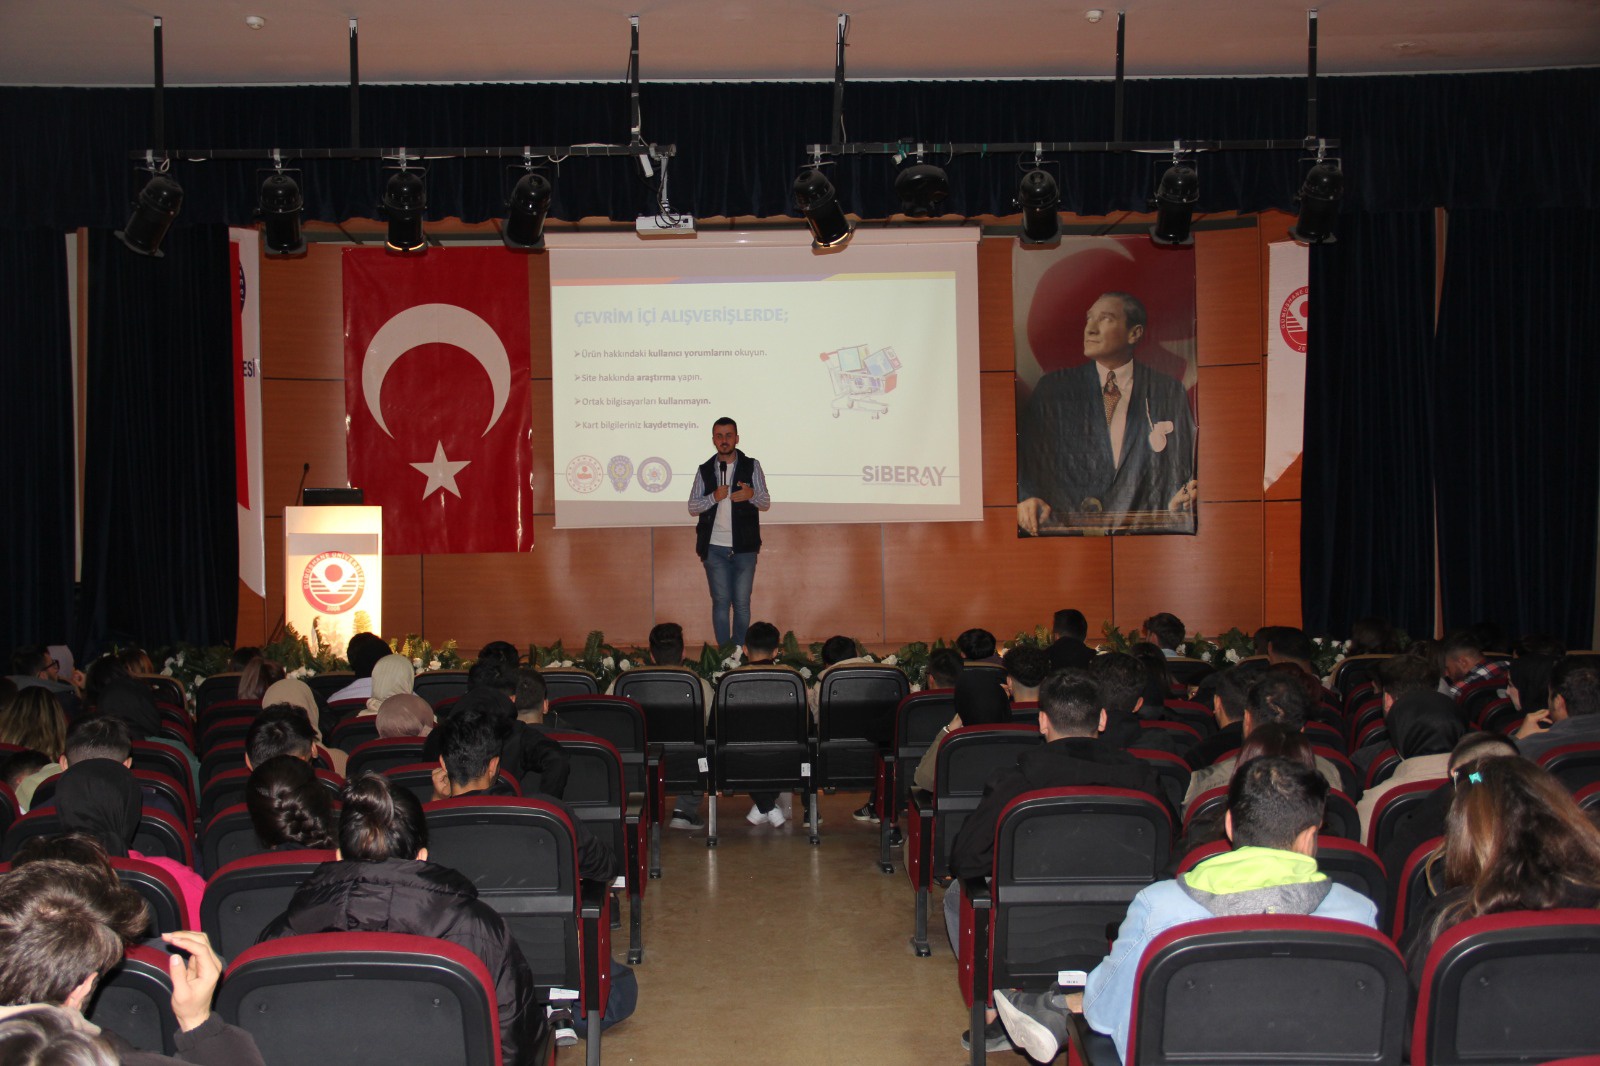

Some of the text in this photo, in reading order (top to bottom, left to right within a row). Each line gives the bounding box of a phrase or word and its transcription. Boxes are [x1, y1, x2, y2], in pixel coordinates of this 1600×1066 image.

[574, 306, 789, 326] ÇEVRİM İÇİ ALIŞVERİŞLERDE;
[581, 348, 767, 360] Ürün hakkındaki kullanıcı yorumlarını okuyun.
[581, 373, 702, 384] Site hakkında araştırma yapın.
[582, 397, 711, 408] Ortak bilgisayarları kullanmayın.
[582, 420, 699, 431] Kart bilgileriniz kaydetmeyin.
